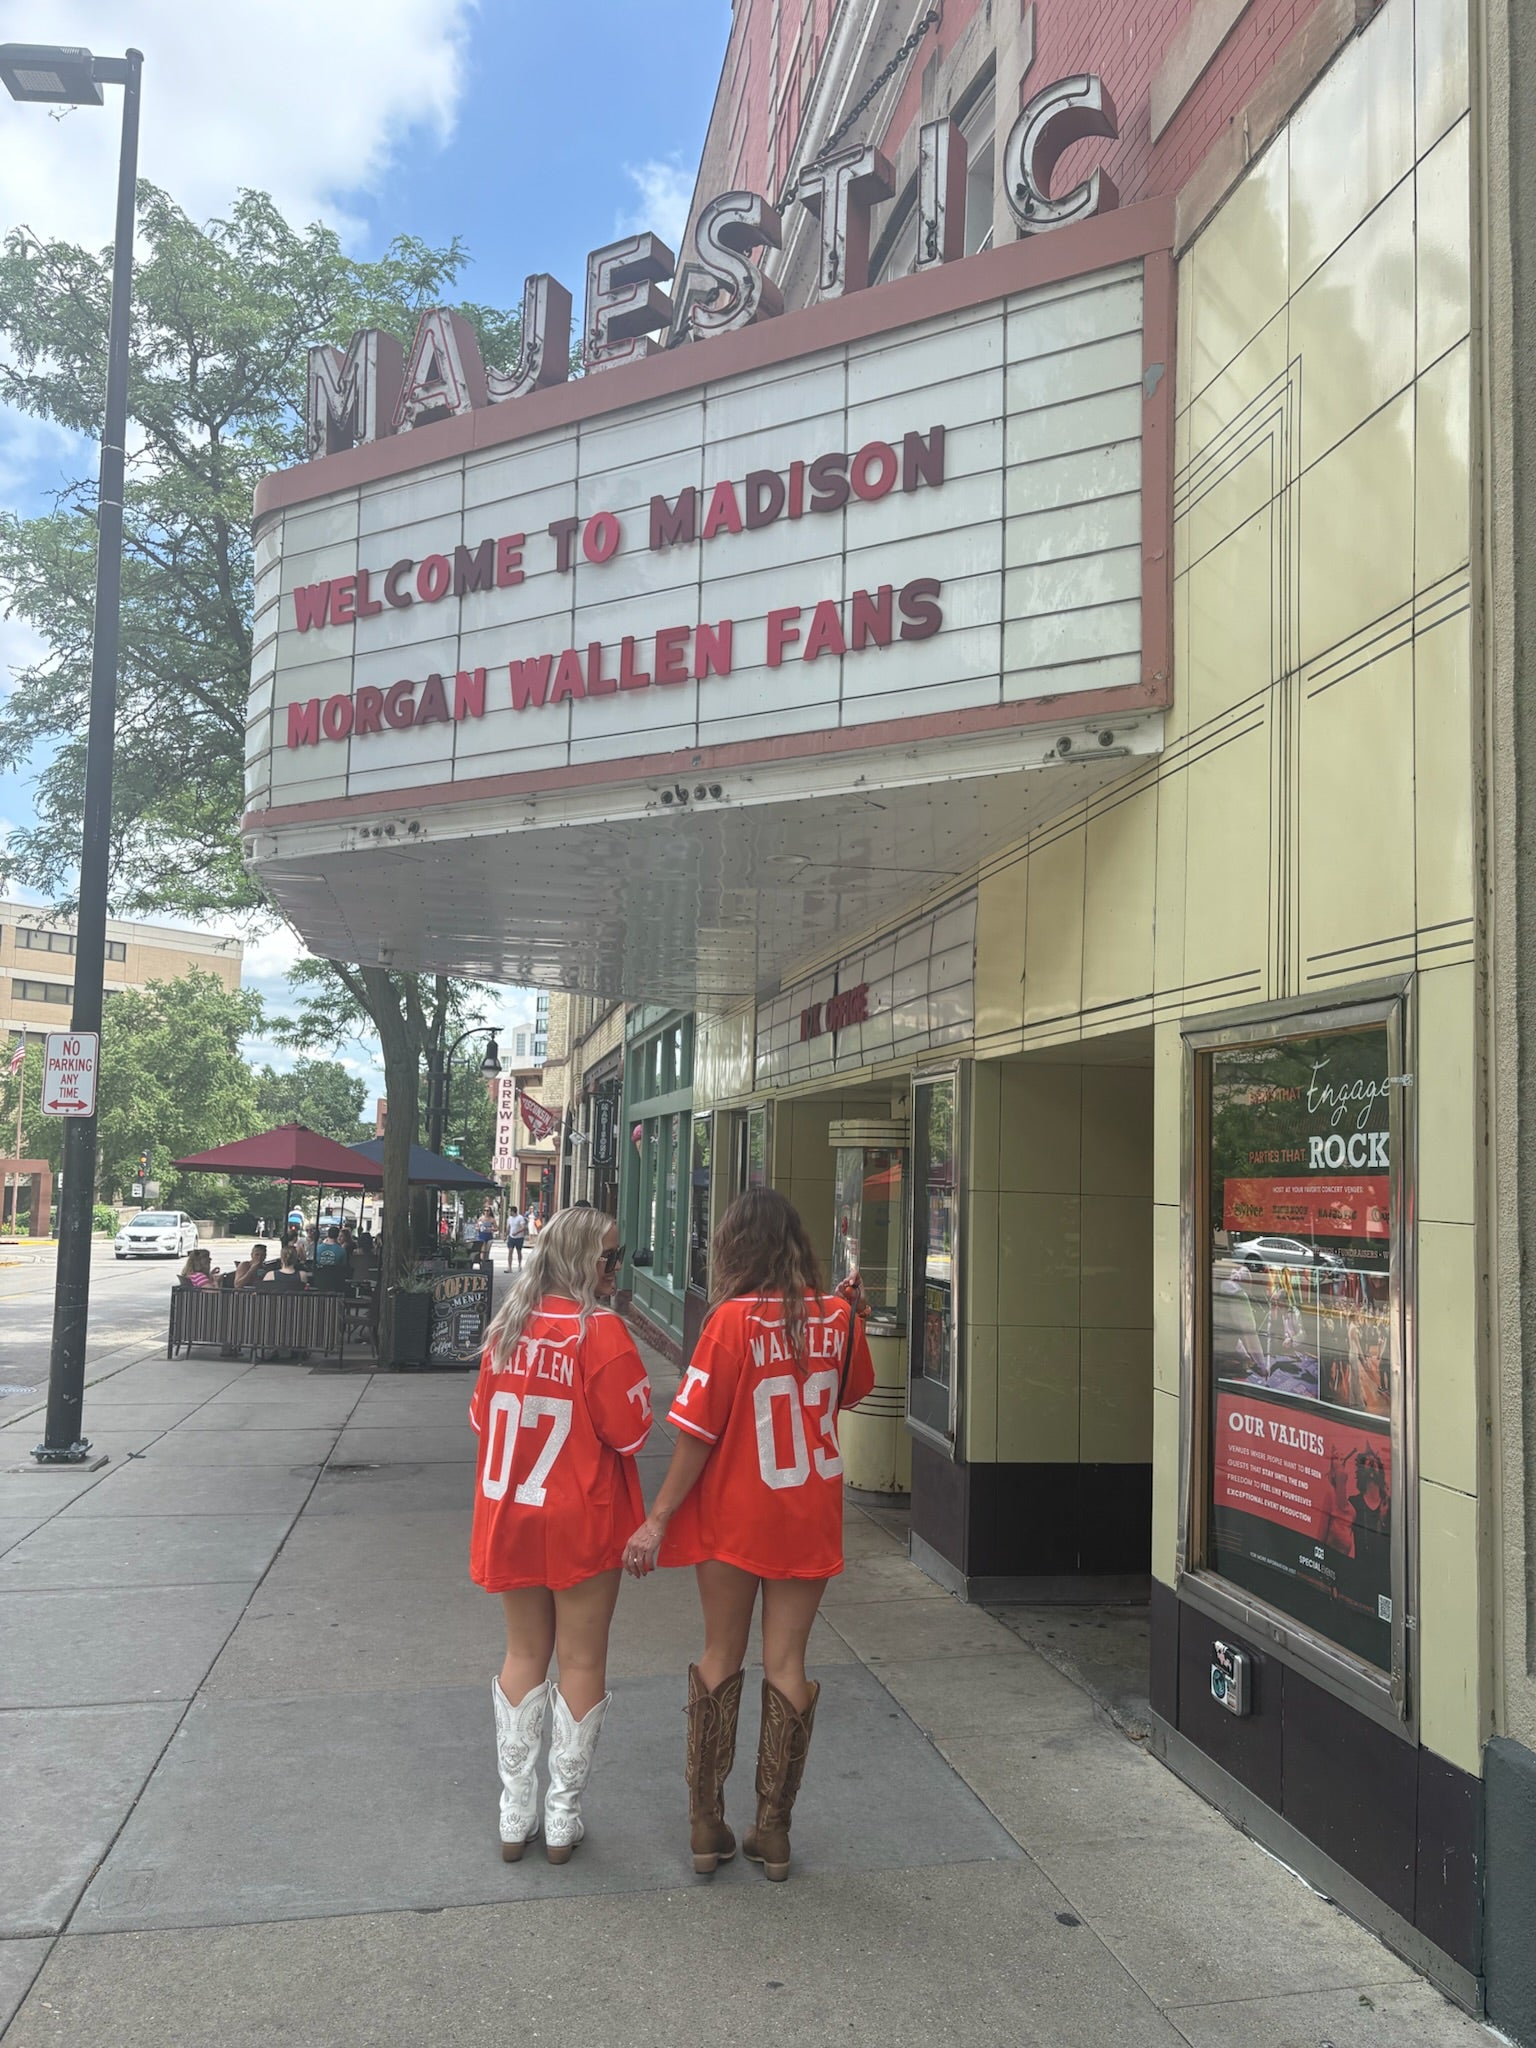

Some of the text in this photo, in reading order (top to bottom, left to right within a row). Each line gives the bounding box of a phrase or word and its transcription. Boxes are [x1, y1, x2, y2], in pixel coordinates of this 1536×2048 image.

[307, 73, 1119, 461] MAJESTIC
[293, 425, 946, 633] WELCOME TO MADISON
[286, 577, 943, 749] MORGAN WALLEN FANS
[48, 1058, 93, 1072] PARKING
[63, 1040, 80, 1056] NO
[59, 1087, 79, 1098] TIME
[60, 1074, 79, 1085] ANY
[1307, 1059, 1390, 1129] Engage
[499, 1079, 512, 1156] BREW PUB
[493, 1157, 518, 1170] POOL
[1249, 1132, 1390, 1168] PARTIES THAT ROCK
[434, 1276, 487, 1301] COFFEE
[453, 1293, 481, 1307] MENU
[676, 1365, 709, 1407] T
[753, 1368, 843, 1490] 03
[1229, 1412, 1324, 1457] OUR VALUES
[482, 1391, 573, 1507] 07
[1228, 1444, 1322, 1479] VENUES WHERE PEOPLE WANT TO BE SEEN
[1227, 1459, 1309, 1490] GUESTS THAT STAY UNTIL THE END
[1227, 1473, 1312, 1507] FREEDOM TO FEEL LIKE YOURSELVES
[1227, 1487, 1312, 1523] EXCEPTIONAL EVENT PRODUCTION
